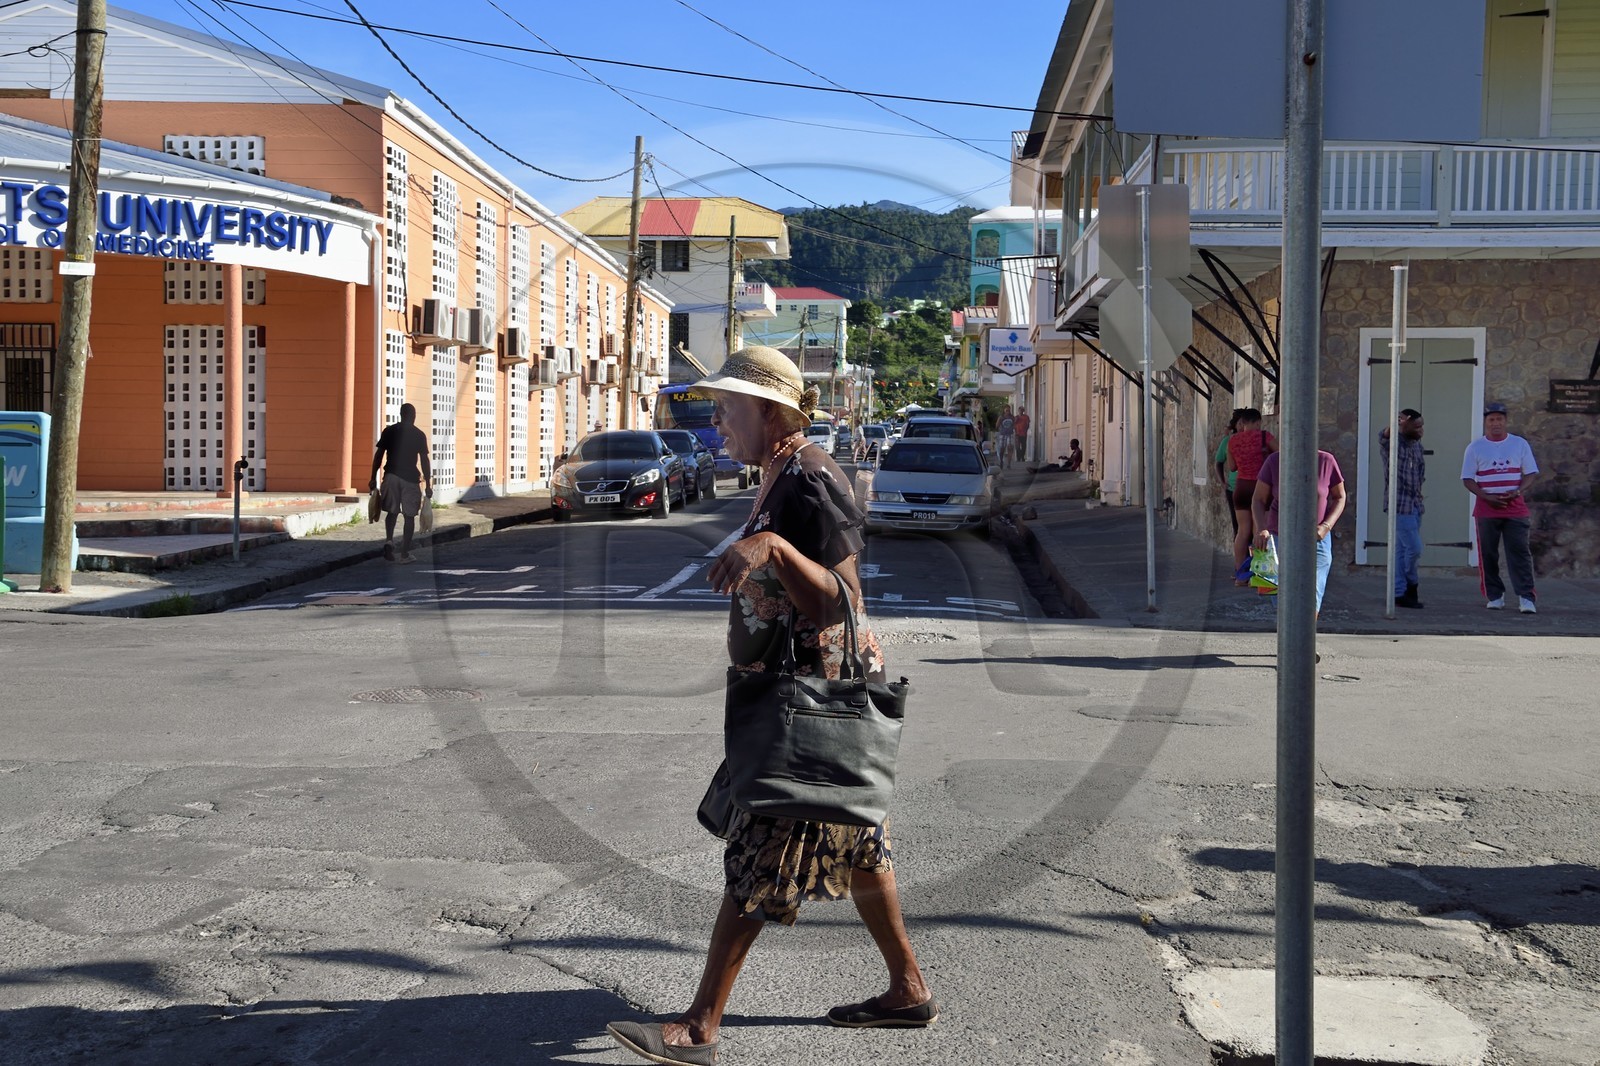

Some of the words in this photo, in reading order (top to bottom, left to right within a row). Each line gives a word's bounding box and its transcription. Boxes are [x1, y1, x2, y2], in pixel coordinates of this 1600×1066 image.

[102, 191, 333, 256] UNIVERSITY
[44, 227, 63, 247] O
[96, 232, 214, 261] MEDICINE
[913, 511, 936, 520] PR019
